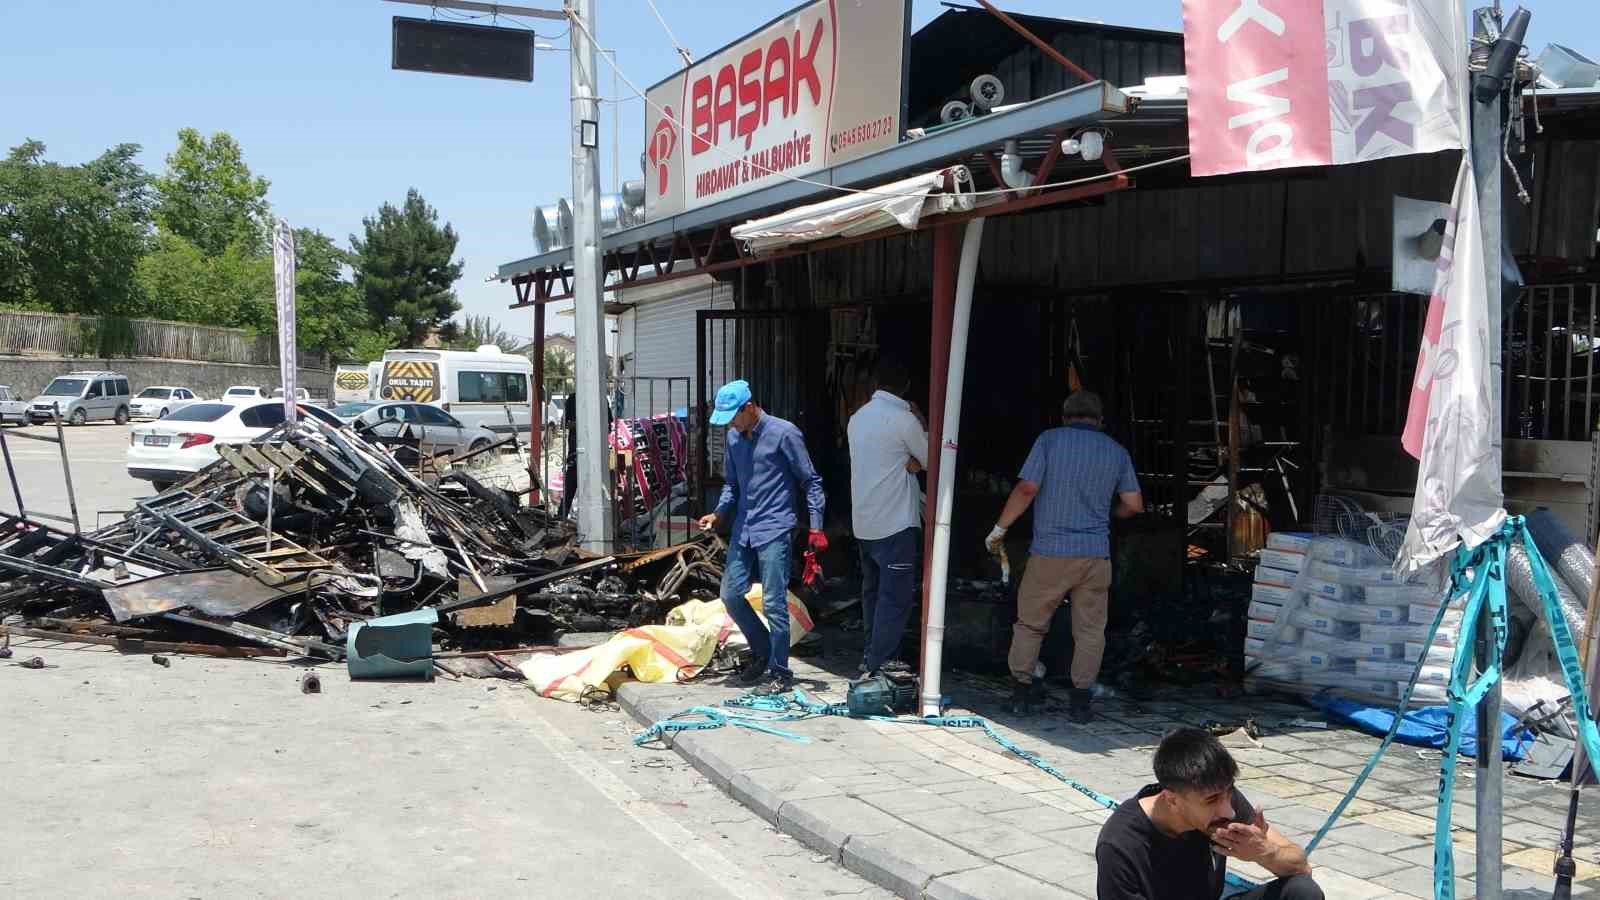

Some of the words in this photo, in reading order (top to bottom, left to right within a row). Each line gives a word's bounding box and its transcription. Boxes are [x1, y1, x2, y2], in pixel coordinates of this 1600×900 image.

[691, 18, 823, 156] BAŞAK
[695, 159, 741, 199] HIRDAVAT
[741, 155, 750, 184] &
[751, 129, 811, 181] NALBURİYE
[388, 378, 409, 386] OKUL
[409, 378, 433, 388] TAŞITI
